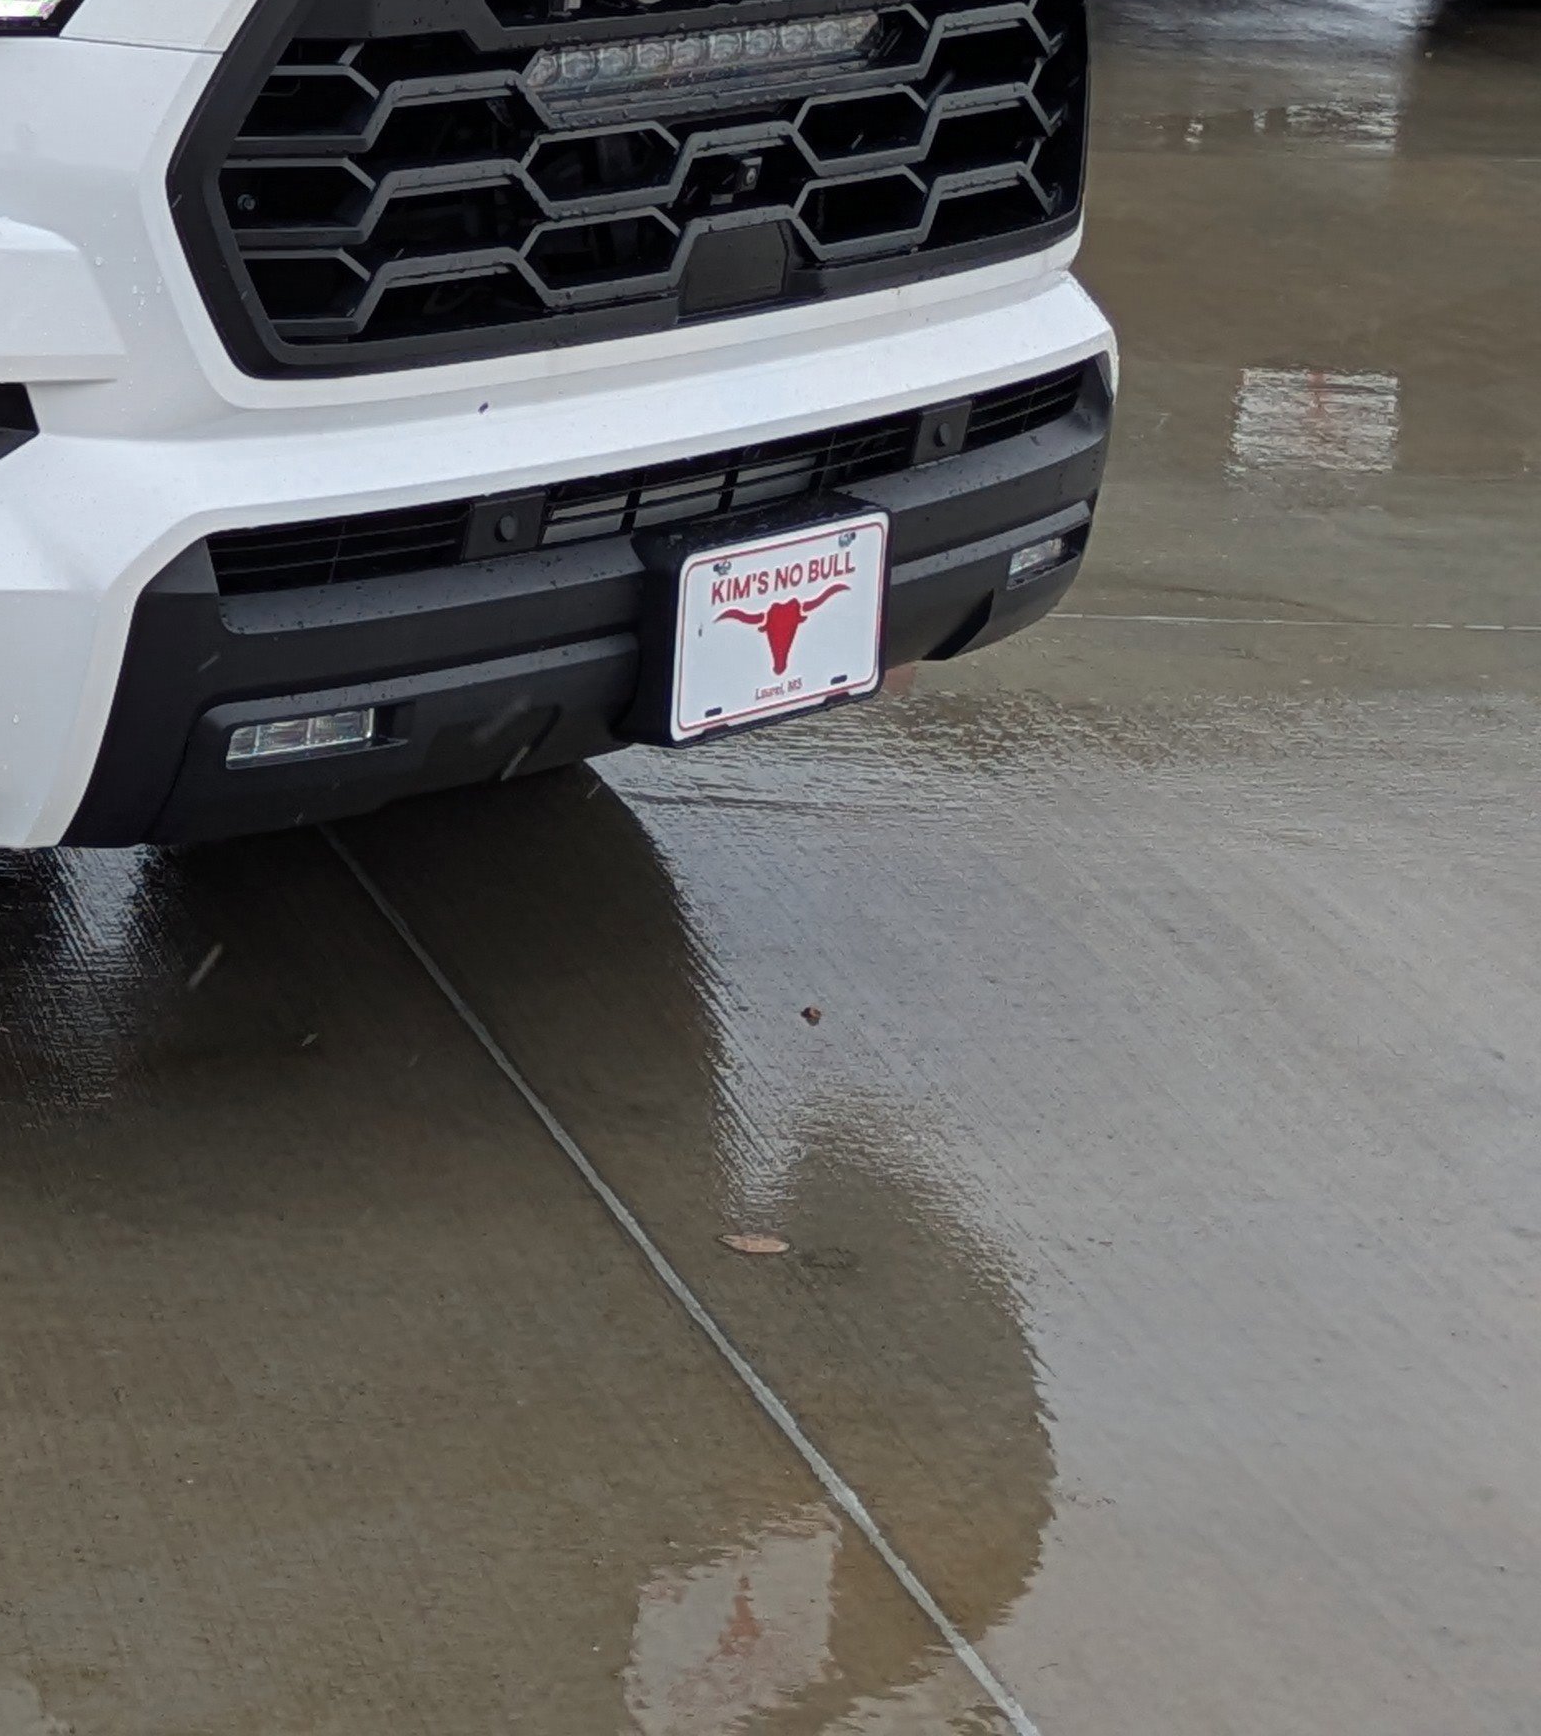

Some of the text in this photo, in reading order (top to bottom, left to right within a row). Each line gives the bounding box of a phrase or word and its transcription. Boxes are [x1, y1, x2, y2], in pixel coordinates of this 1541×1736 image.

[711, 551, 856, 606] KIM'S NO BULL
